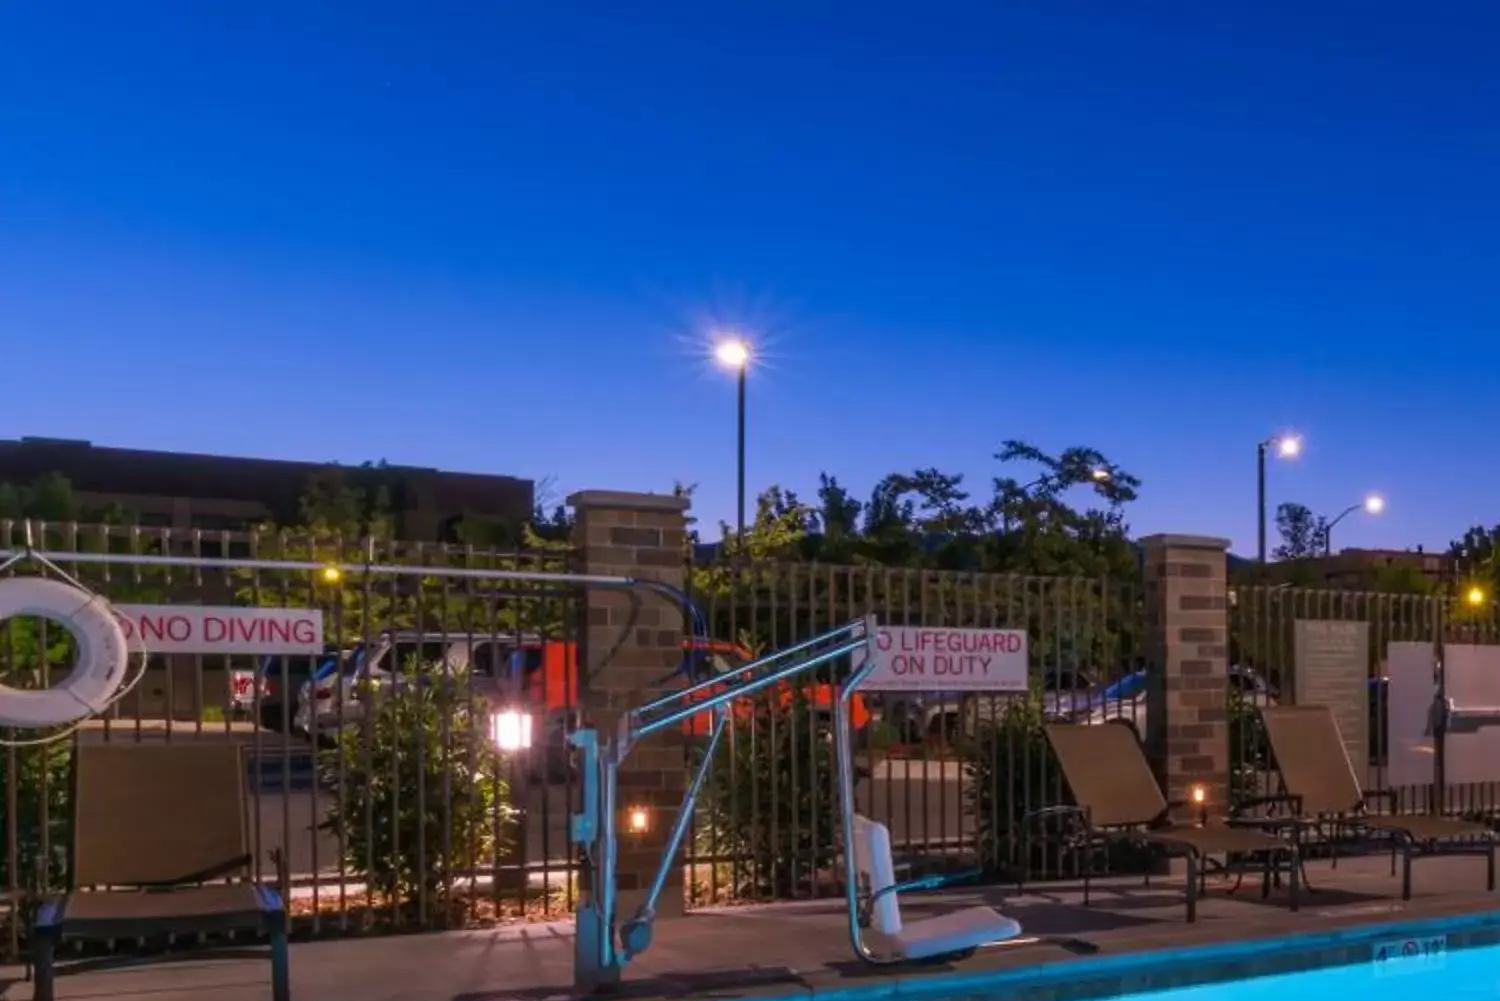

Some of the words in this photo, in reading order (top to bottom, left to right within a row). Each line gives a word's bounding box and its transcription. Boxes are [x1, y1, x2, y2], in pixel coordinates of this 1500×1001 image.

[140, 616, 192, 641] NO
[203, 617, 316, 643] DIVING
[901, 631, 1021, 653] LIFEGUARD
[892, 655, 925, 675] ON
[933, 656, 992, 676] DUTY
